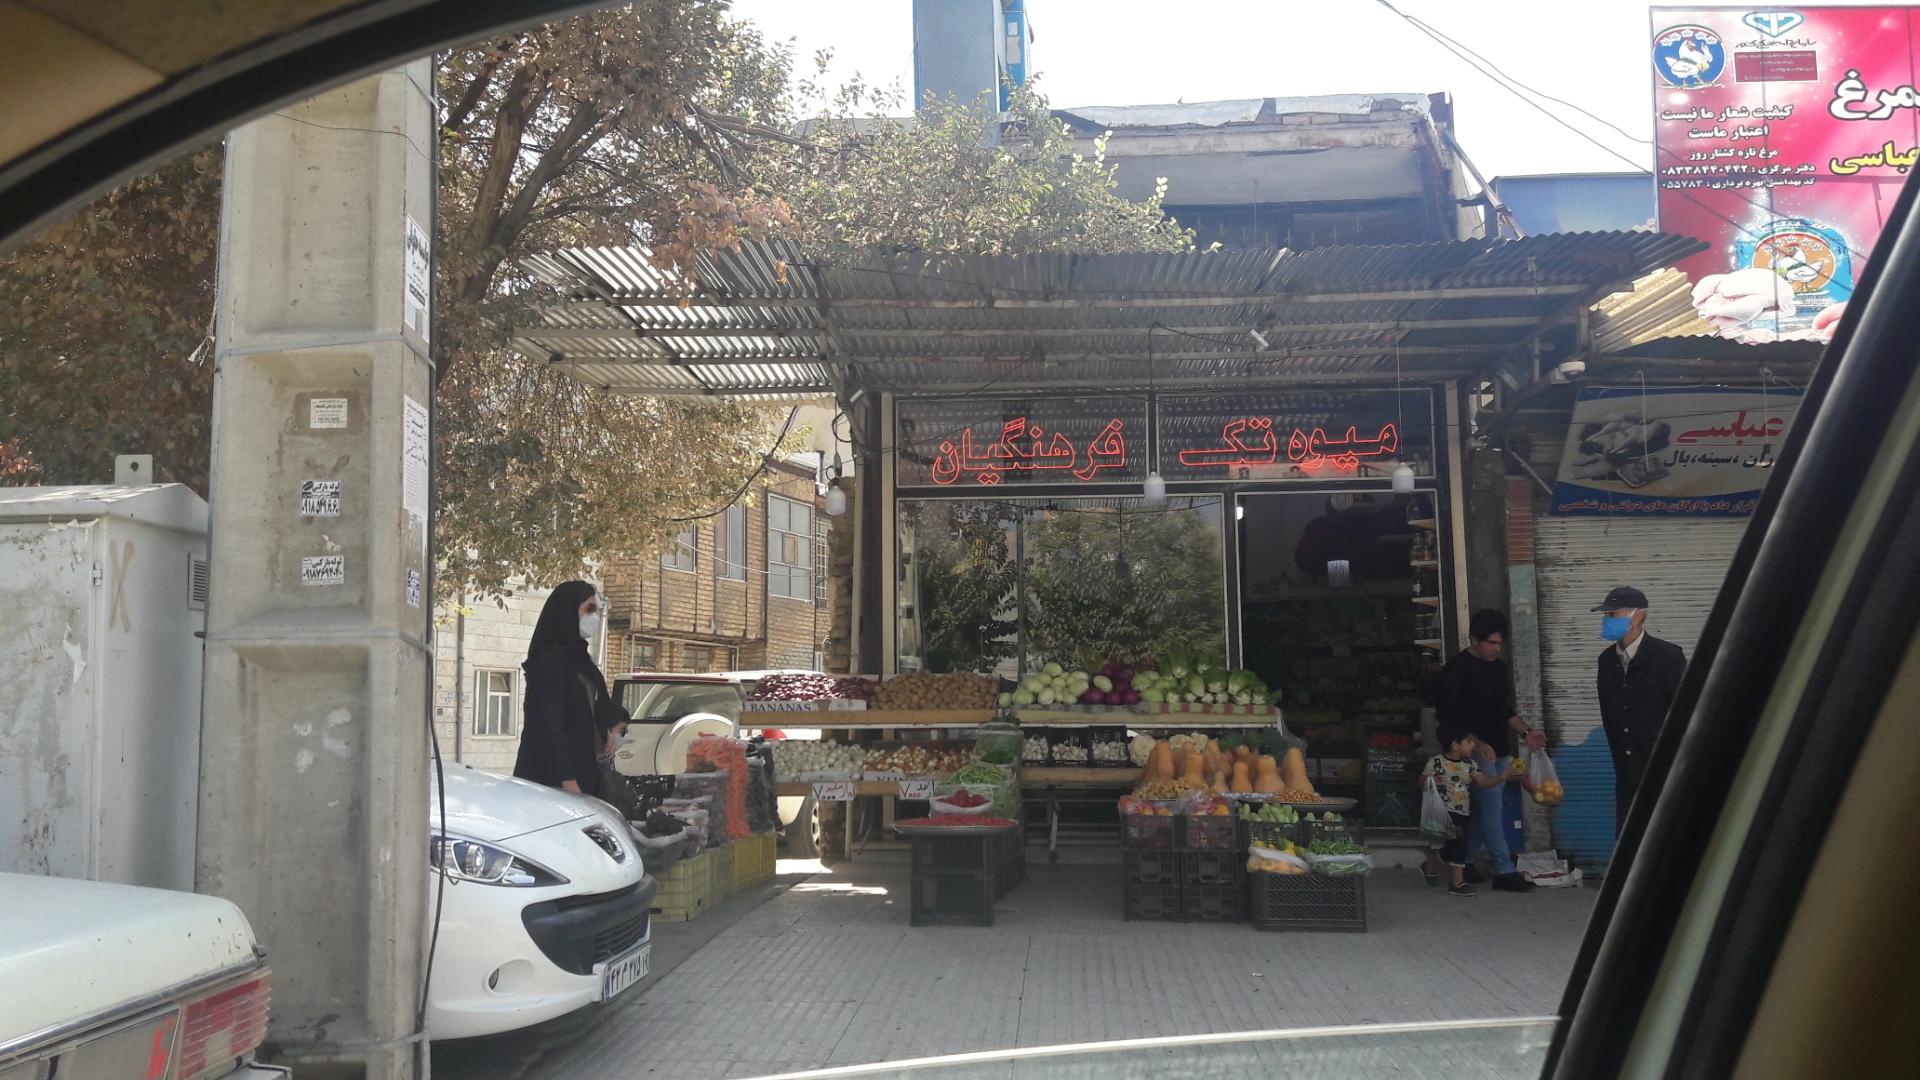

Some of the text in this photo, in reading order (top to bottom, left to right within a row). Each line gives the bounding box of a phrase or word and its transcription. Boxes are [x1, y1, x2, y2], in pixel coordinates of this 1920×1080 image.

[1660, 105, 1794, 122] کیفیت شعار ما نیست
[1688, 125, 1769, 140] اعتبار ماست
[1690, 147, 1778, 161] مرغ تازه کشتار روز
[1758, 164, 1792, 175] مرکزی
[1794, 163, 1816, 174] دفتر
[1711, 180, 1743, 190] برداری
[1803, 177, 1816, 186] کد
[1180, 416, 1398, 469] میوه تک
[932, 416, 1127, 485] فرهنگیان
[750, 703, 812, 712] BANANAS
